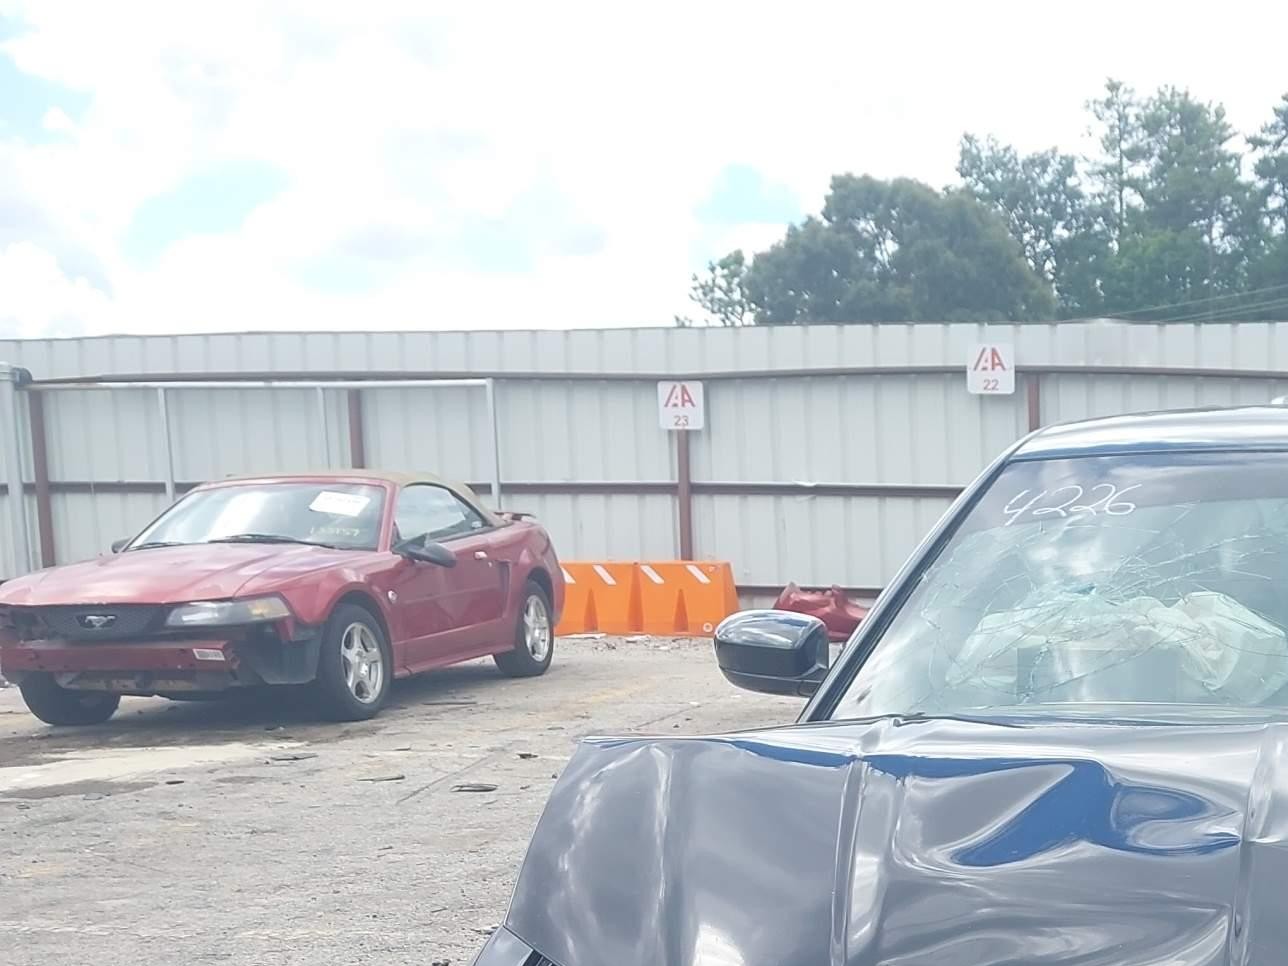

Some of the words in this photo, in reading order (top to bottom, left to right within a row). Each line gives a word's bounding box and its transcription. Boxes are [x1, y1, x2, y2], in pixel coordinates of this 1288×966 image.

[983, 378, 1000, 391] 22
[673, 415, 689, 427] 23
[1003, 483, 1143, 527] 4226
